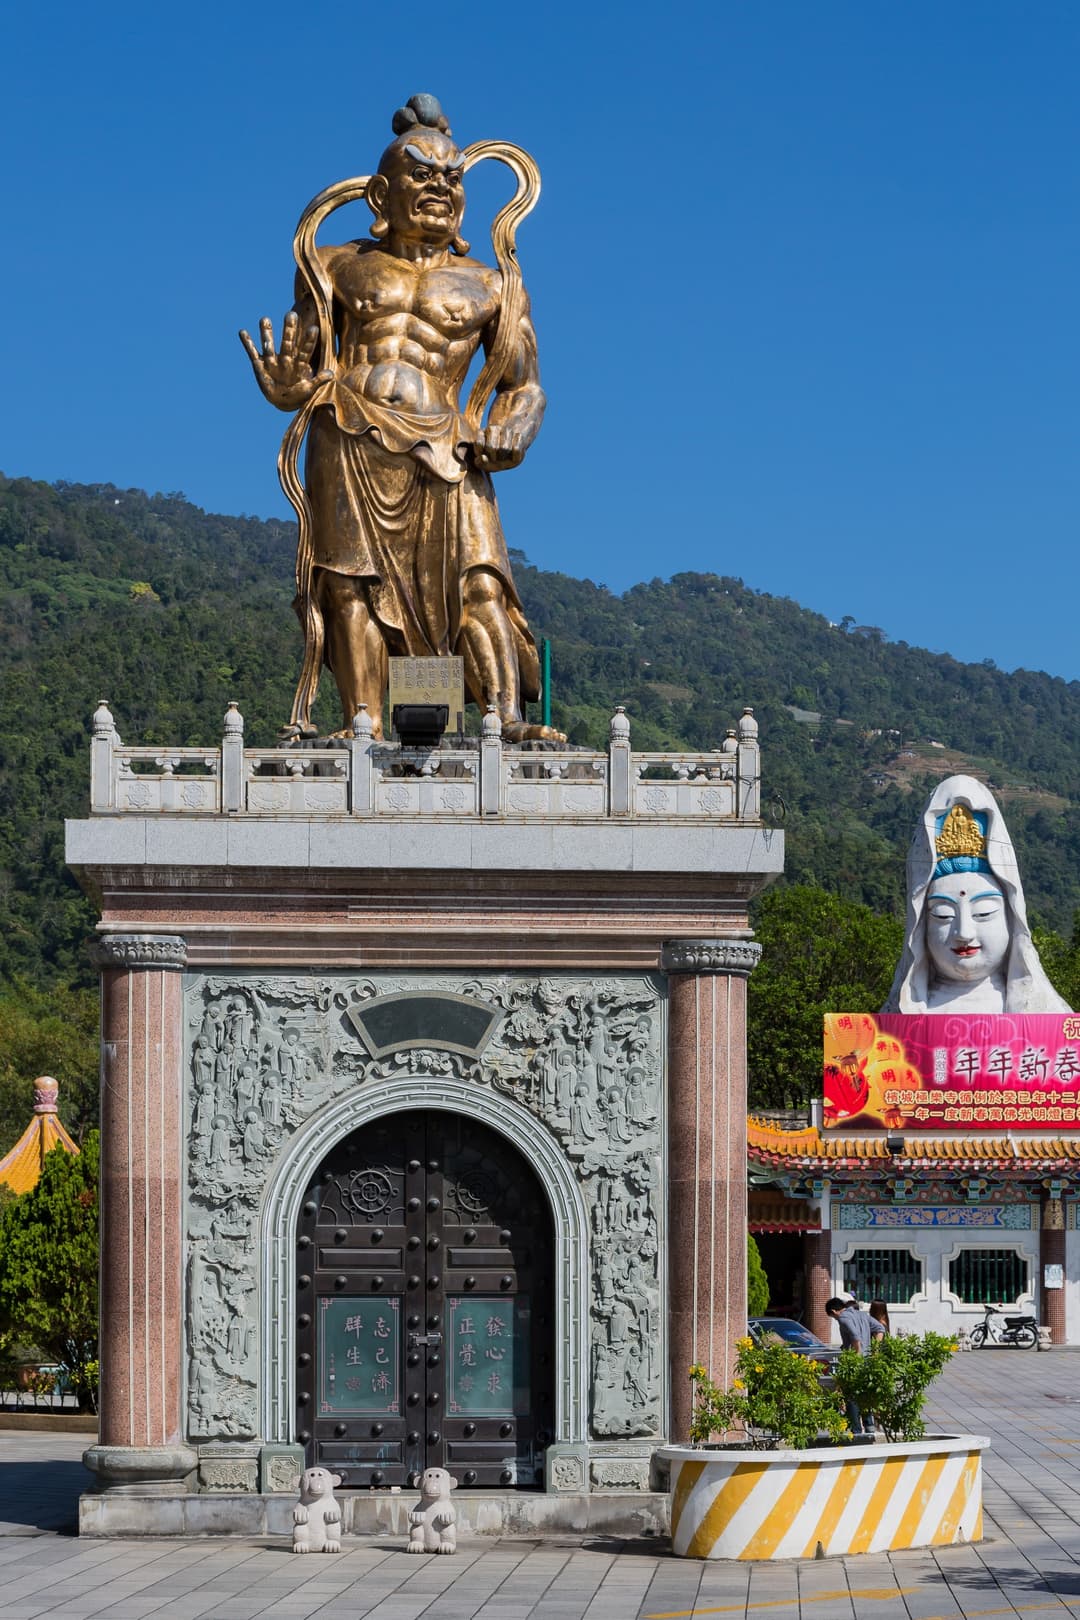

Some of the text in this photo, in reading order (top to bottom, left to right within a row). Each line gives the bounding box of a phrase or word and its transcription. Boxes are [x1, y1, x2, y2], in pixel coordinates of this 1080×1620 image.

[954, 1047, 1080, 1084] 年年新春
[900, 1107, 1080, 1121] 一年一度新春萬佛光明燈吉
